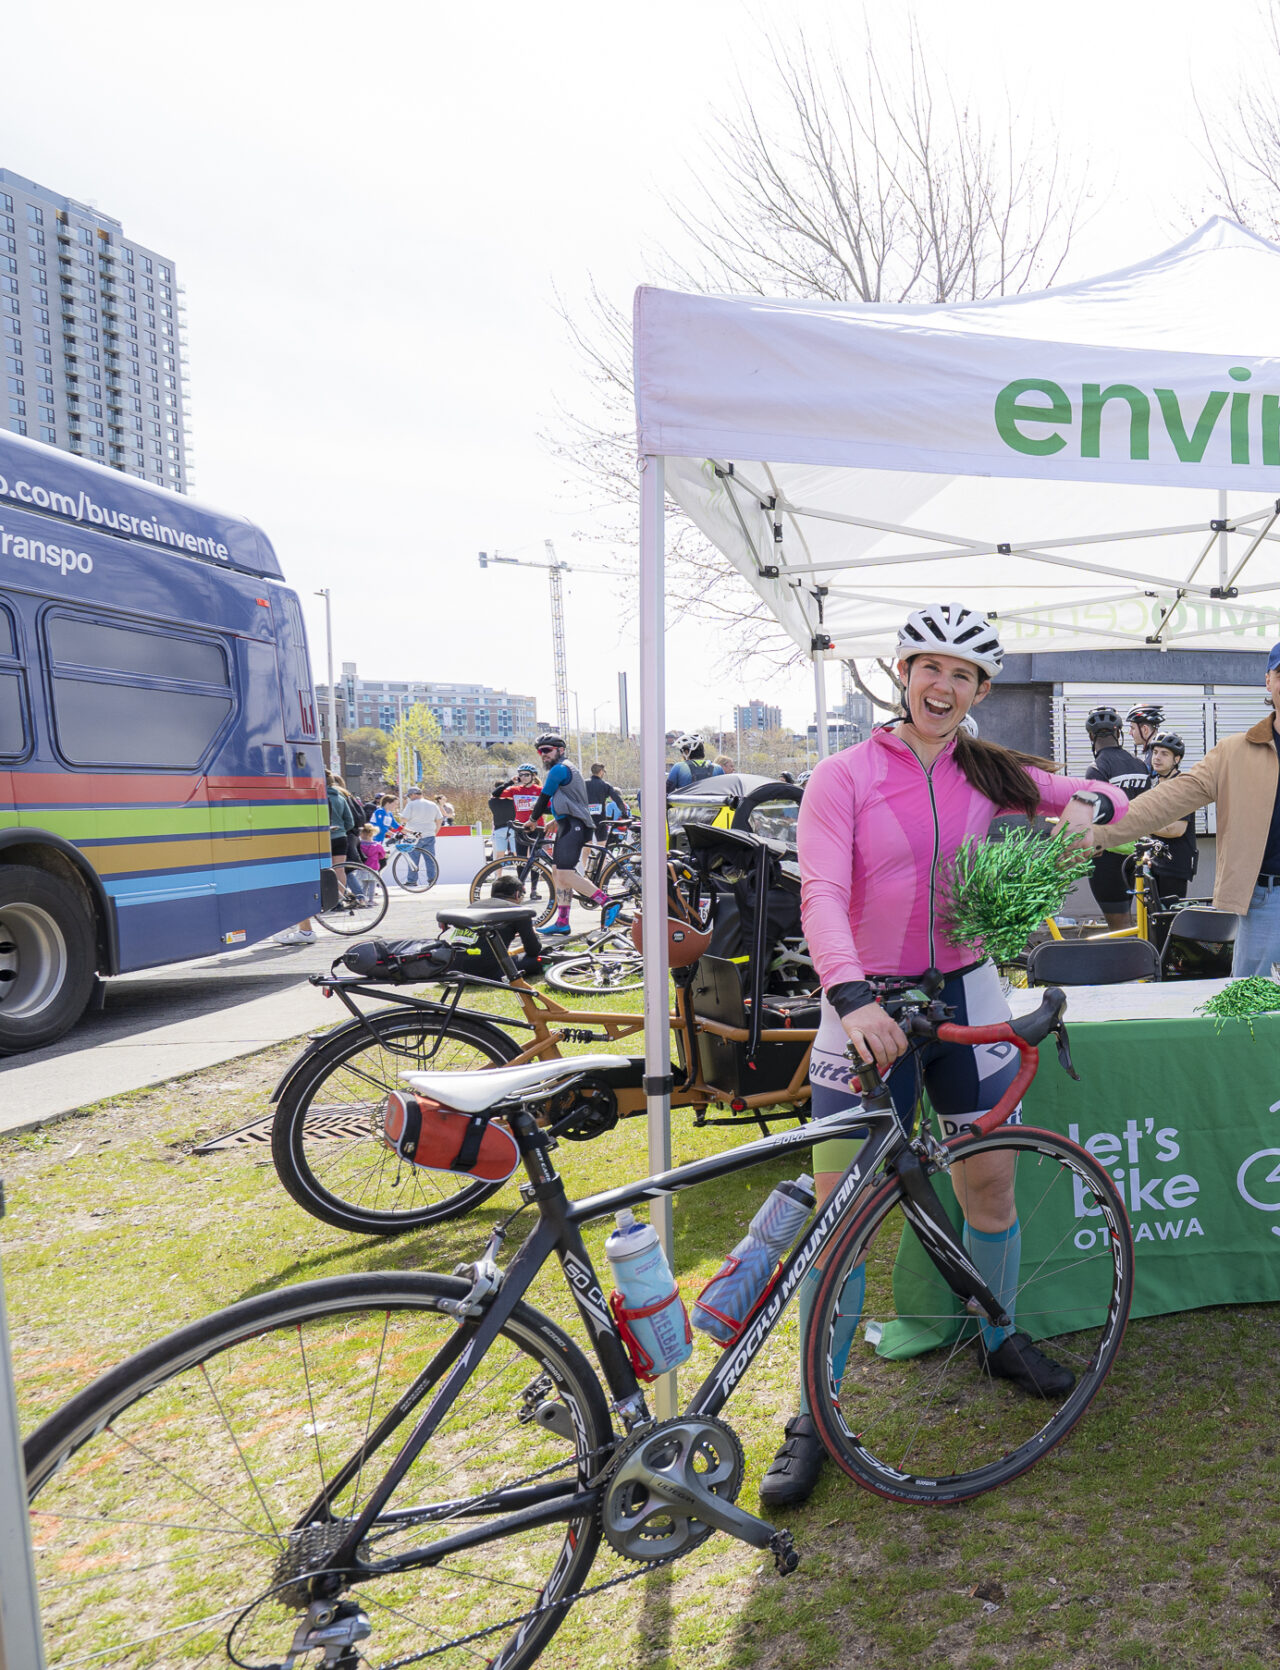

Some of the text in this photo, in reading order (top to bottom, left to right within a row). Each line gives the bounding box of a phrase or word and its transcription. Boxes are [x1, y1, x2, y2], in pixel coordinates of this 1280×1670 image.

[0, 525, 94, 576] ranspo
[1068, 1117, 1180, 1168] let's
[1072, 1165, 1201, 1219] bike
[1073, 1218, 1205, 1250] OTAWA
[720, 1163, 861, 1399] ROCKY MOUNTAIN
[650, 1309, 683, 1366] MELBAK
